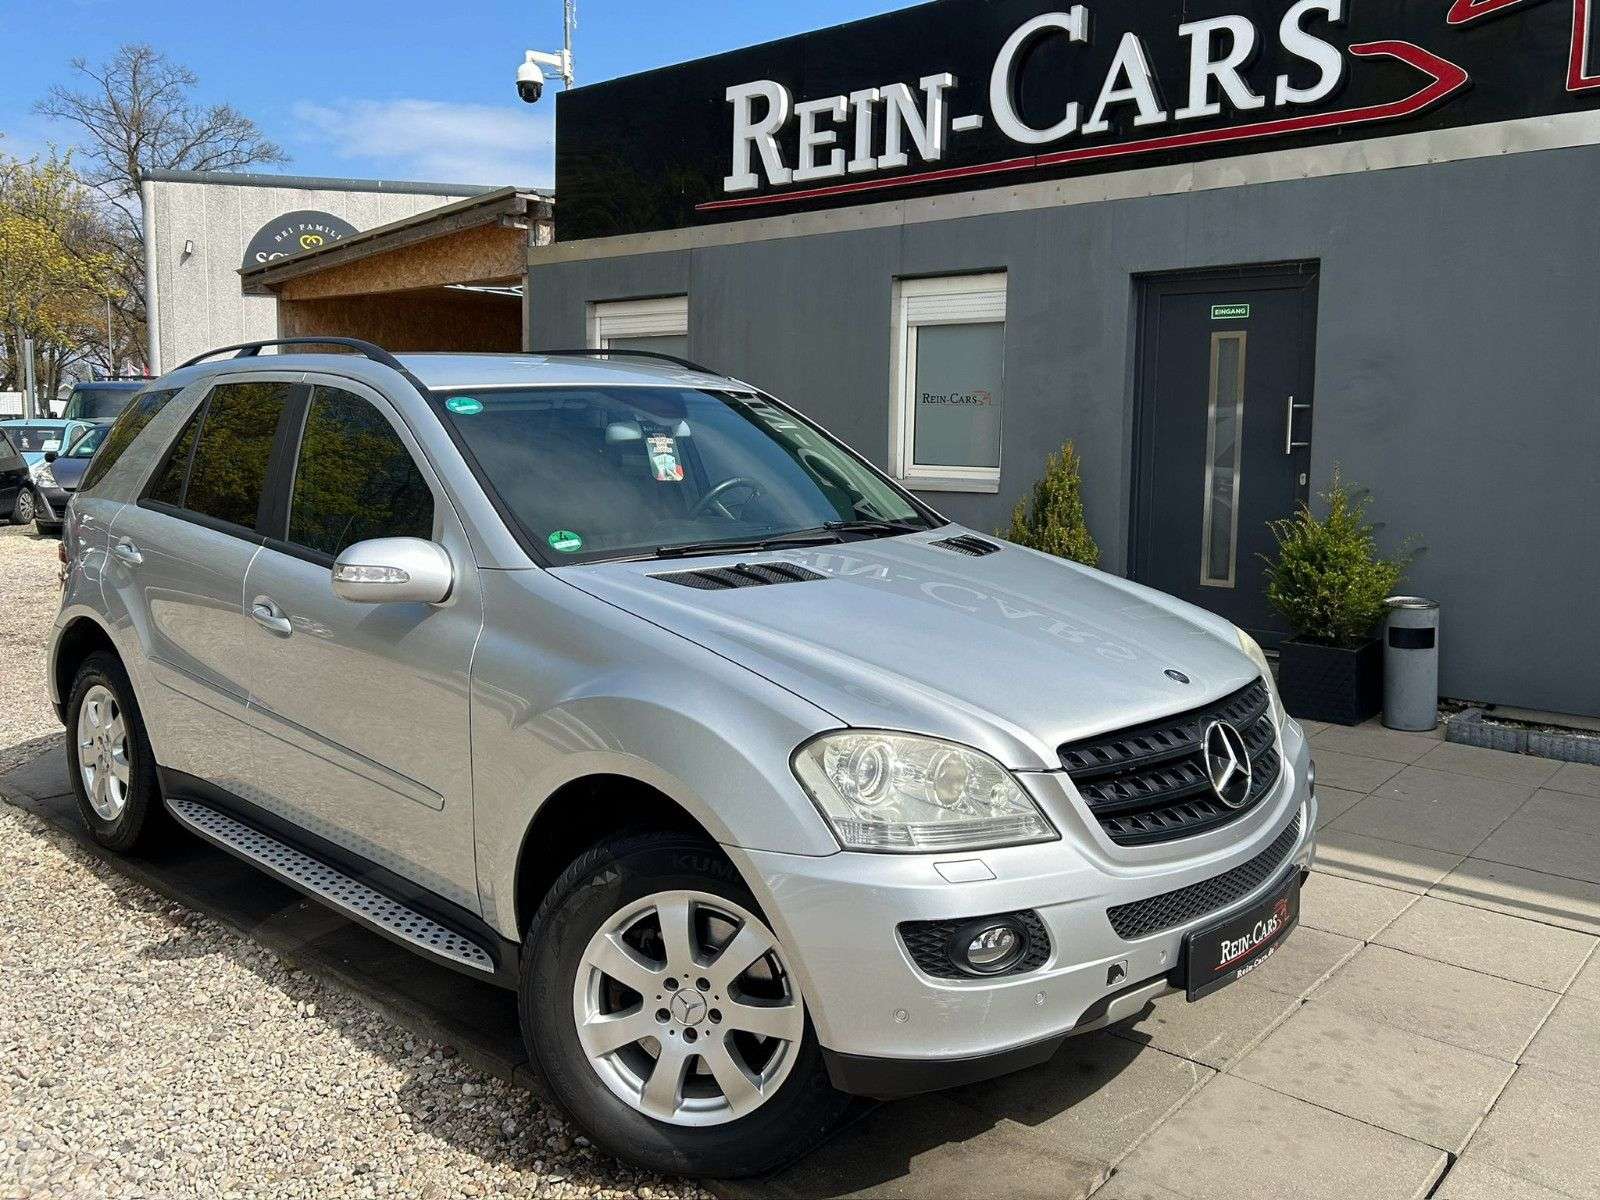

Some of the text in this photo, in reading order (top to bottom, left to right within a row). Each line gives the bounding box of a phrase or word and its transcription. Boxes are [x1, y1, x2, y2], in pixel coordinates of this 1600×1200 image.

[724, 0, 1342, 192] REIN-CARS
[275, 223, 342, 242] BEI FAMILI
[922, 392, 977, 404] REIN-CARS
[1220, 913, 1278, 965] REIN-CARS
